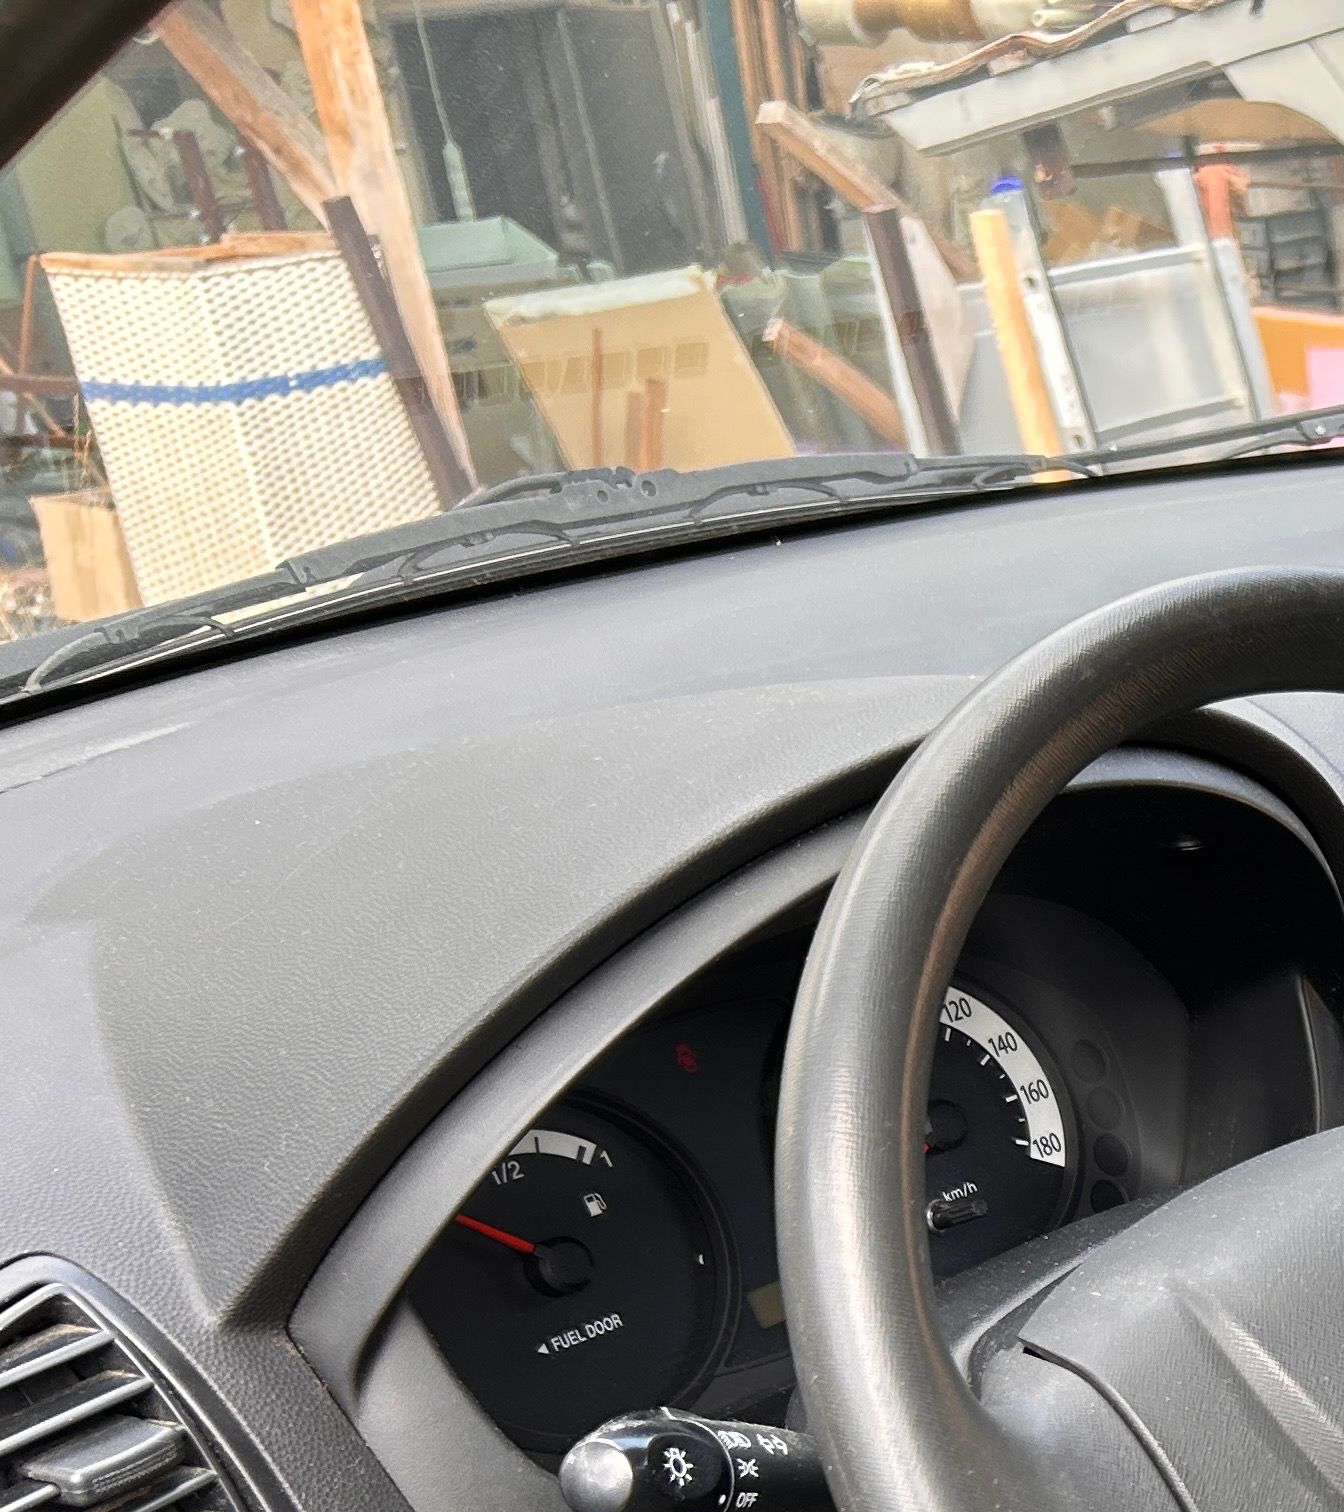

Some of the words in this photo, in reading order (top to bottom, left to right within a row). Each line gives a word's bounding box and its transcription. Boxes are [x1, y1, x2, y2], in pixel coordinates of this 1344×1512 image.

[942, 998, 972, 1023] 120
[988, 1032, 1018, 1057] 140
[1020, 1079, 1050, 1105] 160
[1032, 1132, 1062, 1158] 180
[491, 1160, 525, 1186] 1/2
[600, 1150, 614, 1168] 1
[942, 1181, 978, 1203] km/h
[550, 1328, 587, 1352] FUEL
[585, 1313, 624, 1339] DOOR
[735, 1491, 759, 1509] OFF
